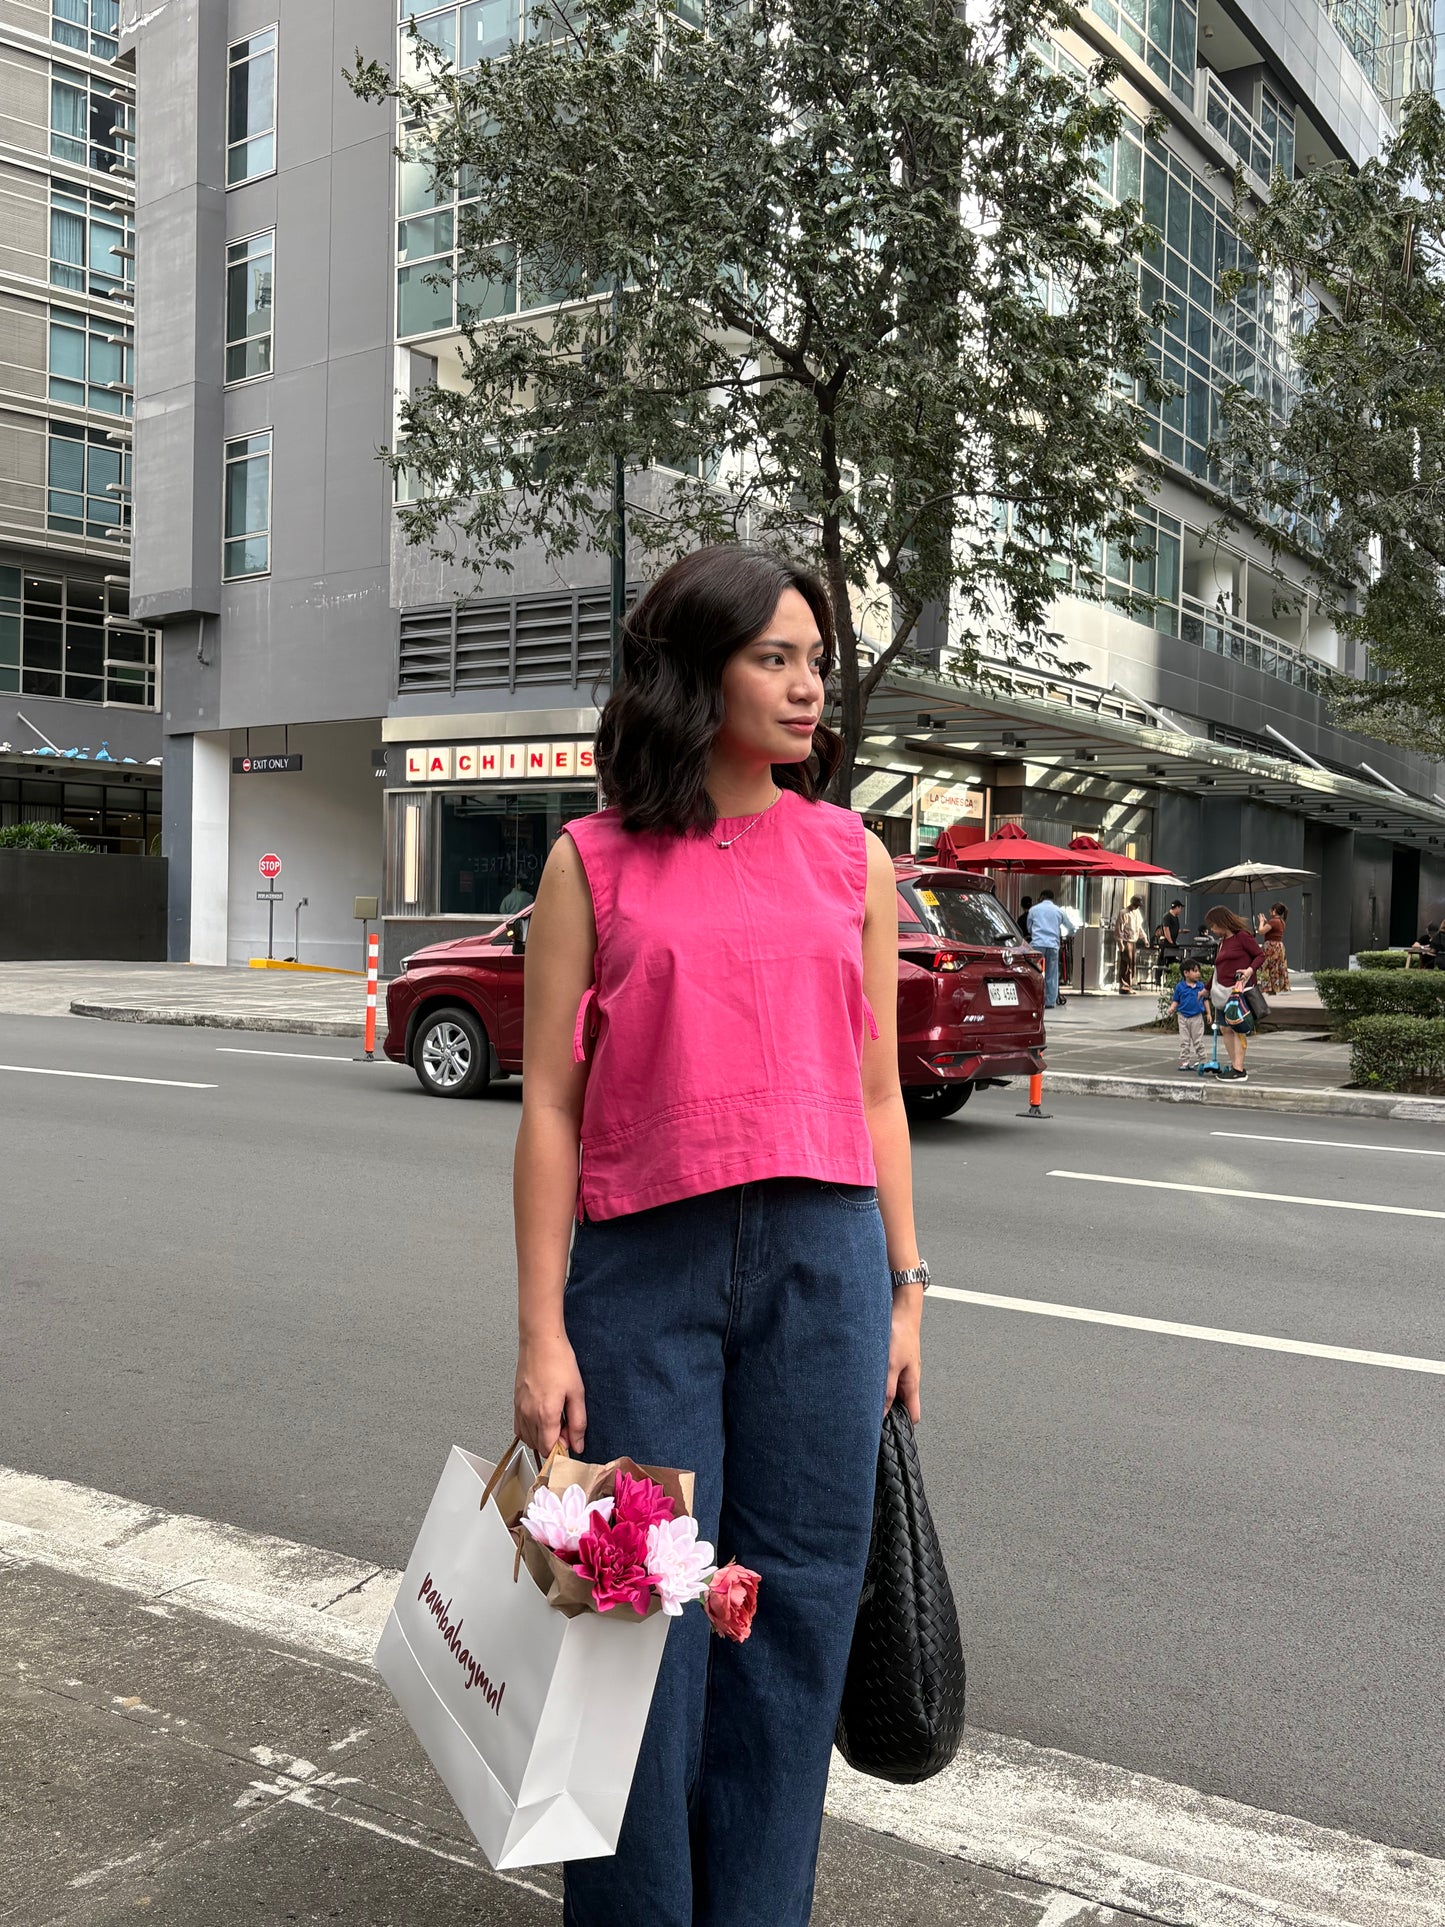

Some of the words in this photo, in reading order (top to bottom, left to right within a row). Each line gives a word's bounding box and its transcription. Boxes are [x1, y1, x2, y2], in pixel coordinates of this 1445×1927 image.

[253, 759, 267, 770] EXIT
[268, 758, 289, 769] ONLY
[929, 793, 940, 803] LA
[261, 860, 280, 871] STOP
[417, 1571, 506, 1716] pambahaymnl
